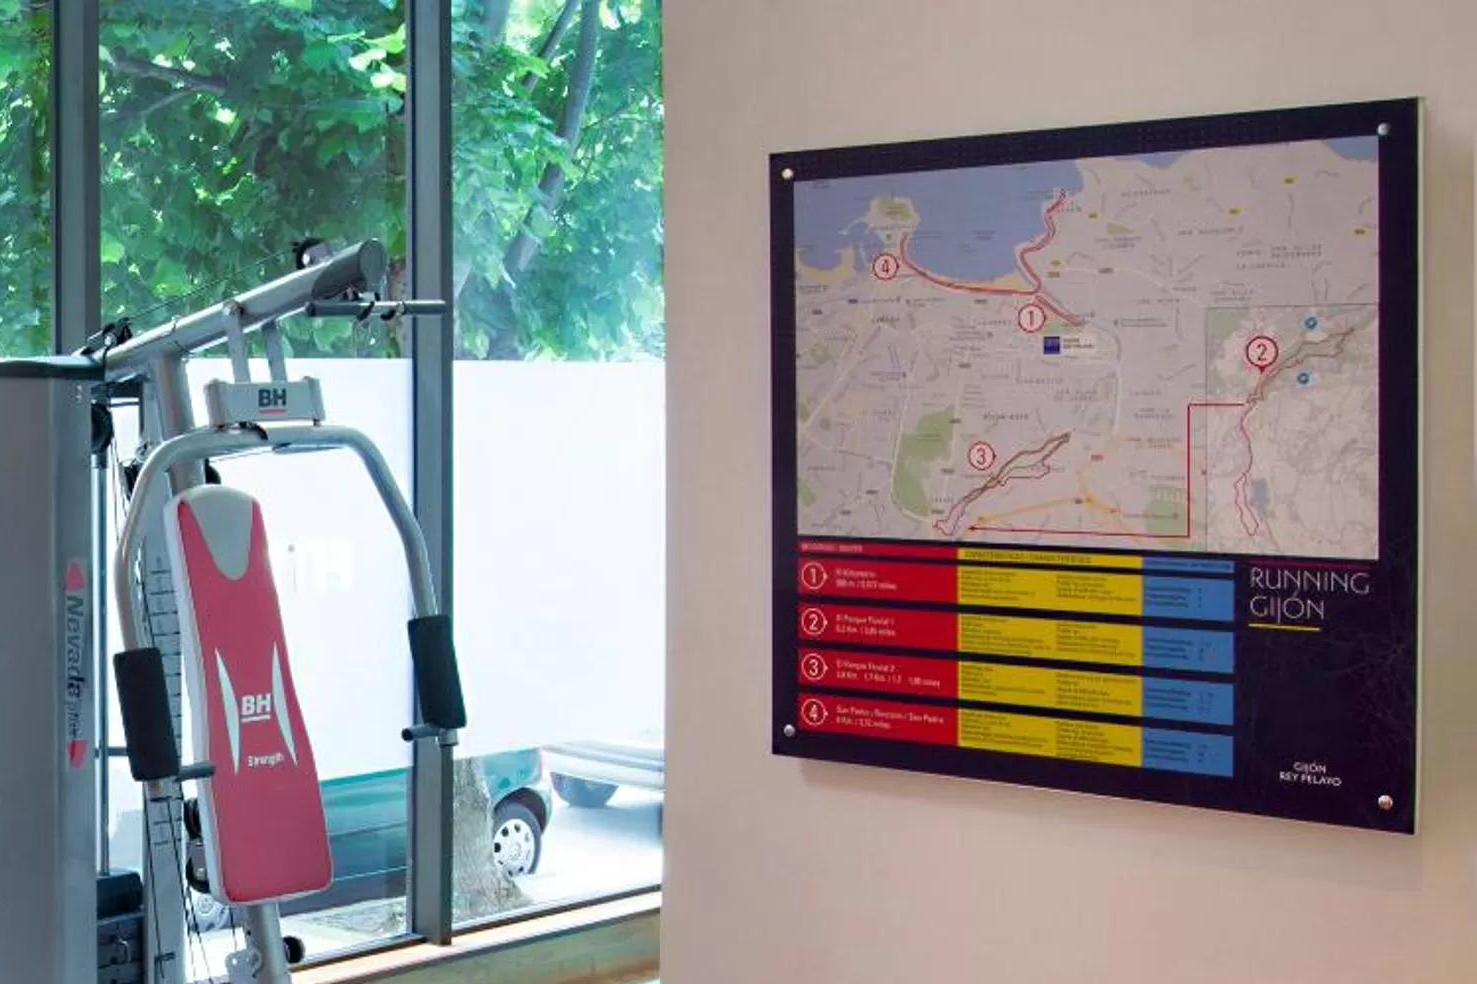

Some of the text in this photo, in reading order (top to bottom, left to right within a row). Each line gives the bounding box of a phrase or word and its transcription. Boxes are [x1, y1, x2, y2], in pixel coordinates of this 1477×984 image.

[879, 256, 892, 277] 4
[1255, 342, 1269, 362] 2
[258, 388, 287, 407] BH
[976, 447, 988, 466] 3
[1250, 566, 1371, 594] RUNNING
[1250, 592, 1326, 624] GIJÓN
[809, 615, 818, 631] 2
[66, 593, 87, 698] Nevada
[809, 660, 818, 676] 3
[240, 693, 272, 716] BH
[809, 705, 818, 721] 4
[247, 751, 285, 768] Strength
